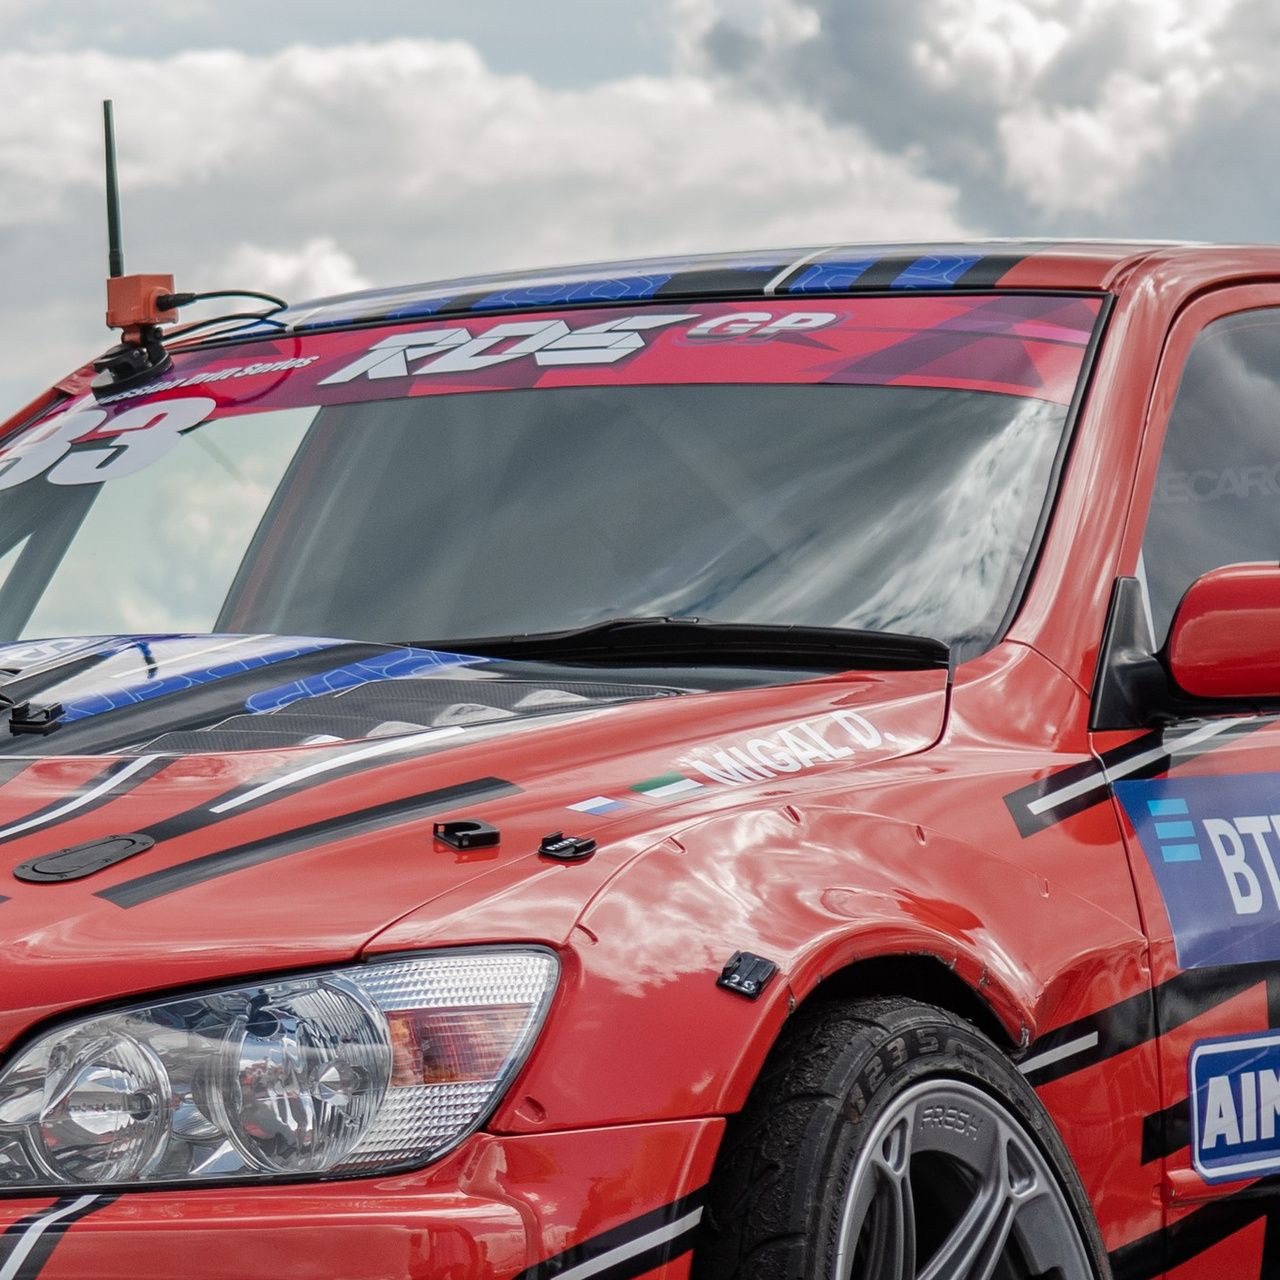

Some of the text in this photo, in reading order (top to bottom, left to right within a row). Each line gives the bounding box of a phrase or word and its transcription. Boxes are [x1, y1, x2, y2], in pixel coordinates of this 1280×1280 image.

[233, 355, 321, 378] Series
[320, 312, 836, 385] RDS GP
[690, 710, 898, 786] MIGAL D.
[1202, 814, 1280, 915] ВТ
[920, 1105, 984, 1141] FRESH
